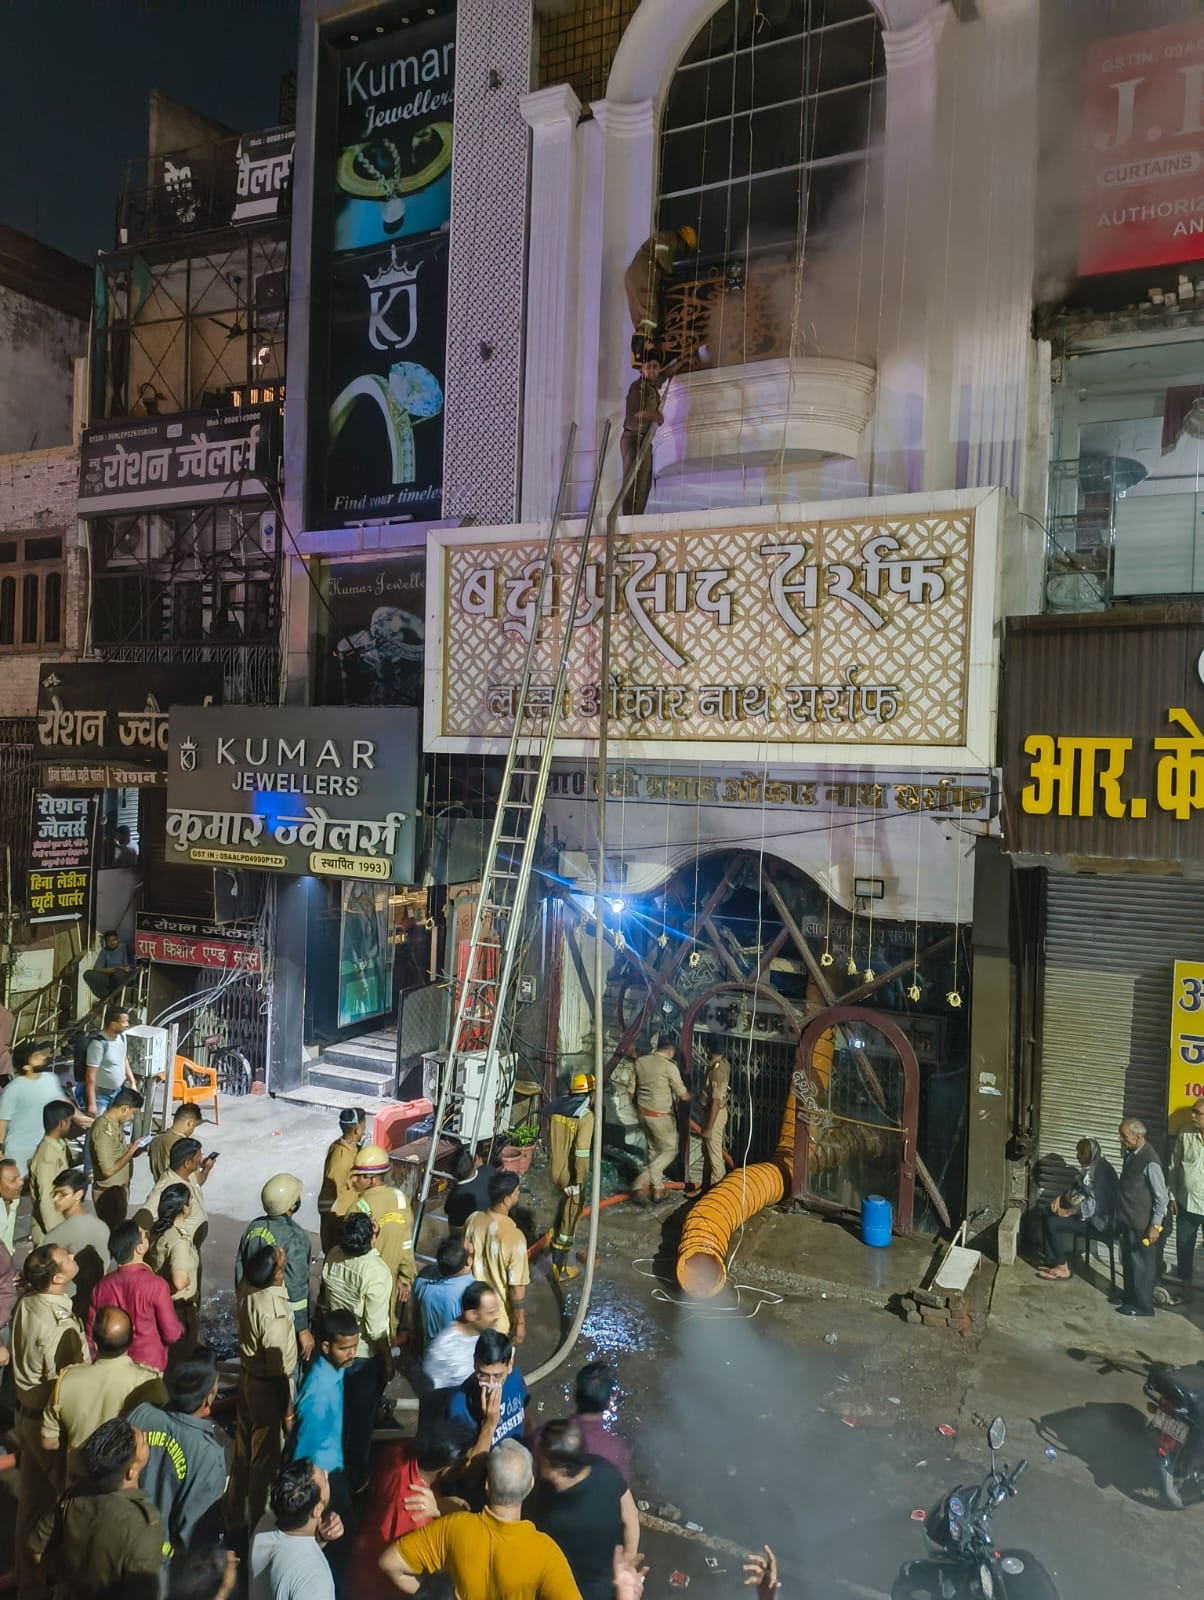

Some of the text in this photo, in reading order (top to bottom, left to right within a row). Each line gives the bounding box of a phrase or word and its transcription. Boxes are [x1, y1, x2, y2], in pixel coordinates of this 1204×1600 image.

[346, 41, 455, 106] Kumar
[1103, 155, 1192, 184] CURTAINS
[103, 443, 173, 488] रोशन
[334, 495, 368, 511] Find
[370, 494, 396, 507] your
[700, 684, 772, 722] नाथ
[785, 665, 899, 723] सर्राफ
[38, 695, 108, 748] रोशन
[216, 737, 377, 769] KUMAR
[111, 768, 158, 784] रोशन
[231, 771, 360, 797] JEWELLERS
[37, 794, 90, 815] रोशन
[37, 816, 88, 838] ज्वैलर्स
[165, 806, 407, 856] कुमार ज्वैलर्स
[30, 871, 88, 891] हिना लेडीज
[31, 889, 85, 914] ब्यूटी पार्लर
[153, 918, 198, 933] रोशन
[138, 939, 157, 960] राम
[162, 938, 197, 960] किशोर
[202, 946, 227, 963] एण्ड
